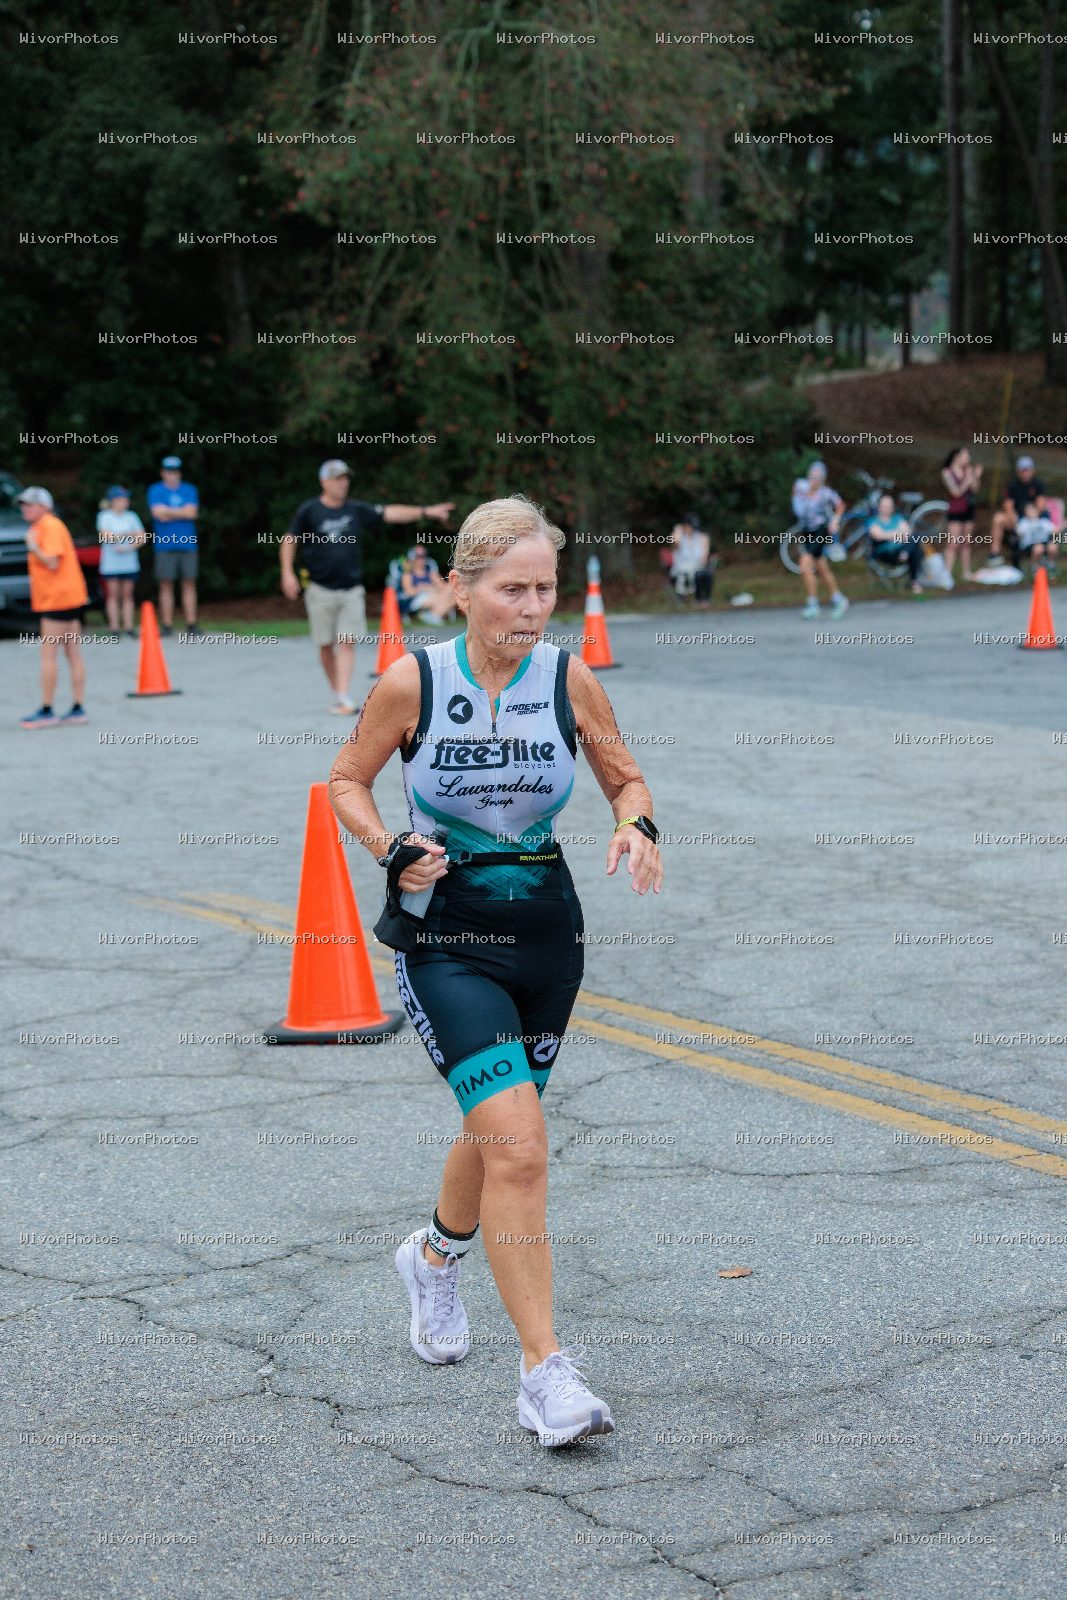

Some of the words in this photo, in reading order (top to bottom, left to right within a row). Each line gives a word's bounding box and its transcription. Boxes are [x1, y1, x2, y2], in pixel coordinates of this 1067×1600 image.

[505, 701, 550, 712] CADENCE
[430, 737, 556, 771] free-flite
[513, 762, 556, 770] bicycles
[436, 775, 554, 797] Lawandales
[474, 795, 514, 810] Group
[528, 852, 558, 861] NATHAN
